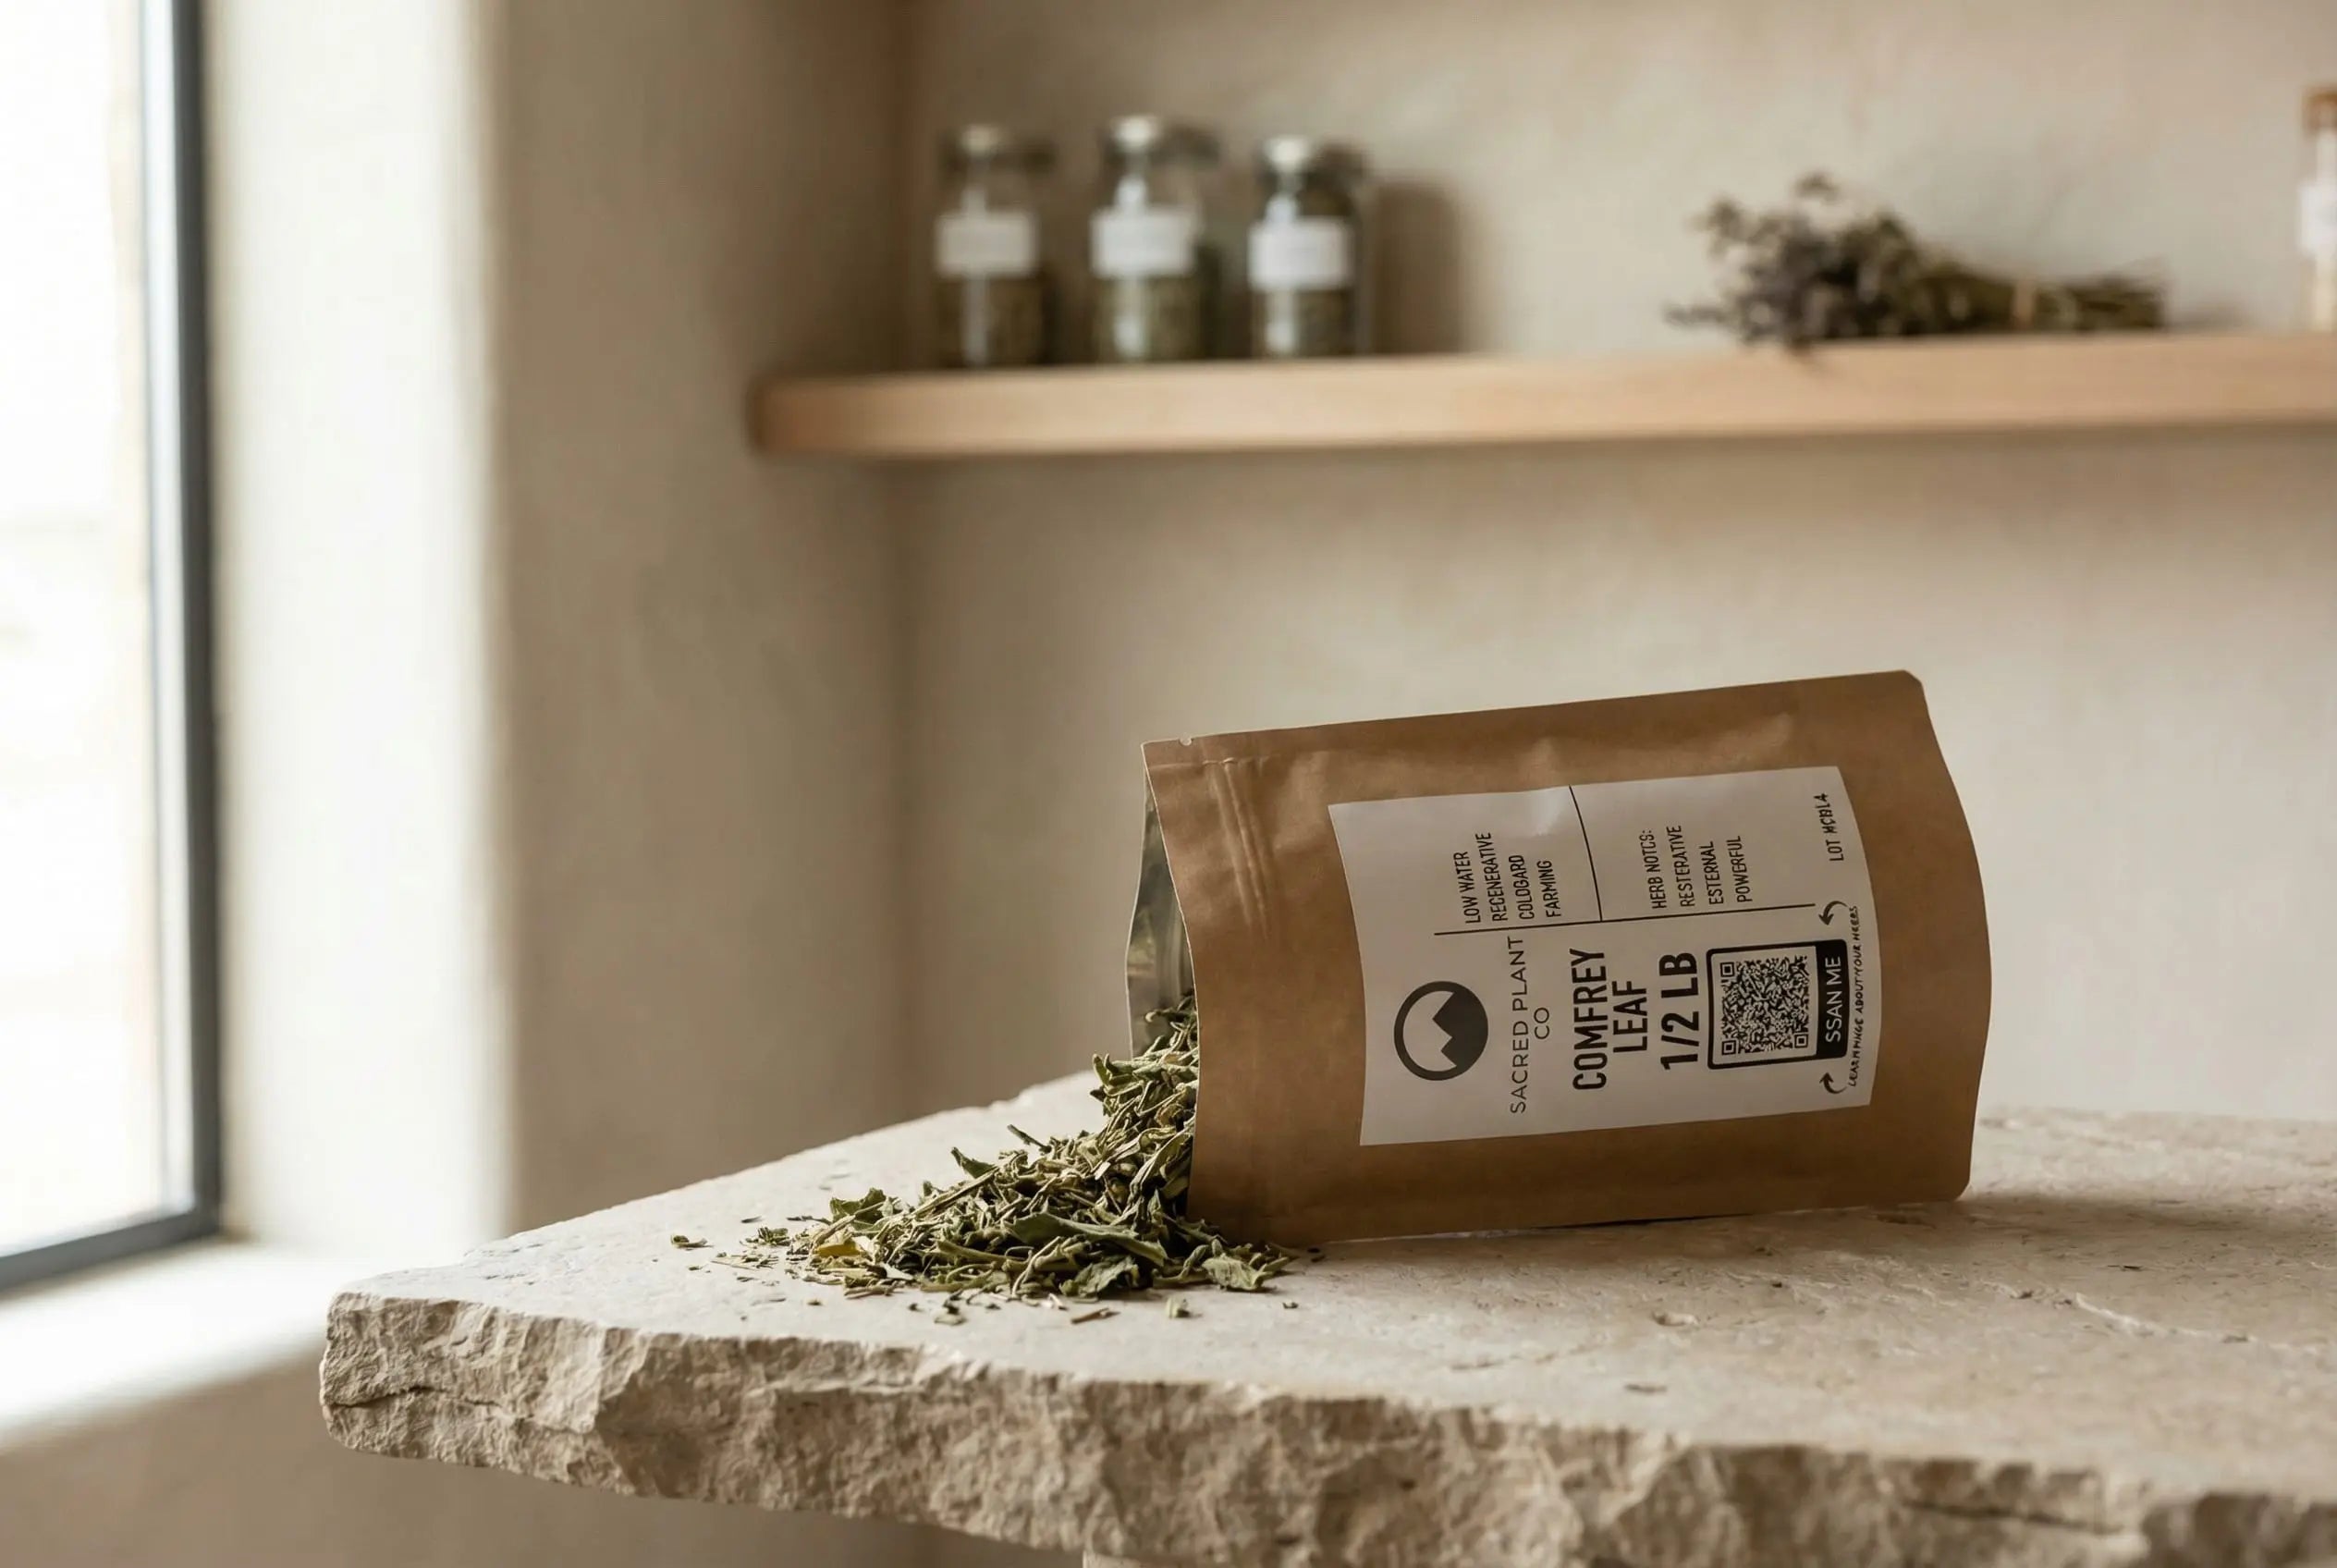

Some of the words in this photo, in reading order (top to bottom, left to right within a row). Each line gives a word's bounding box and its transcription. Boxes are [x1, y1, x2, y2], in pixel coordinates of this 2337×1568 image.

[1453, 851, 1475, 893] WATER
[1699, 840, 1724, 905] ESTERNAL
[1726, 835, 1753, 902] POWERFUL
[1827, 840, 1844, 862] LOT
[1461, 895, 1481, 924] LOW
[1536, 860, 1561, 917] FARMING
[1647, 876, 1667, 909] HERB
[1507, 936, 1528, 1011] PLANT
[1658, 952, 1698, 999] LB
[1825, 956, 1842, 986] ME
[1534, 1007, 1550, 1040] CO
[1569, 949, 1609, 1090] COMFREY
[1611, 980, 1648, 1053] LEAF
[1659, 1011, 1699, 1070] 1/2
[1825, 991, 1842, 1042] SSAN
[1510, 1020, 1529, 1114] SACRED
